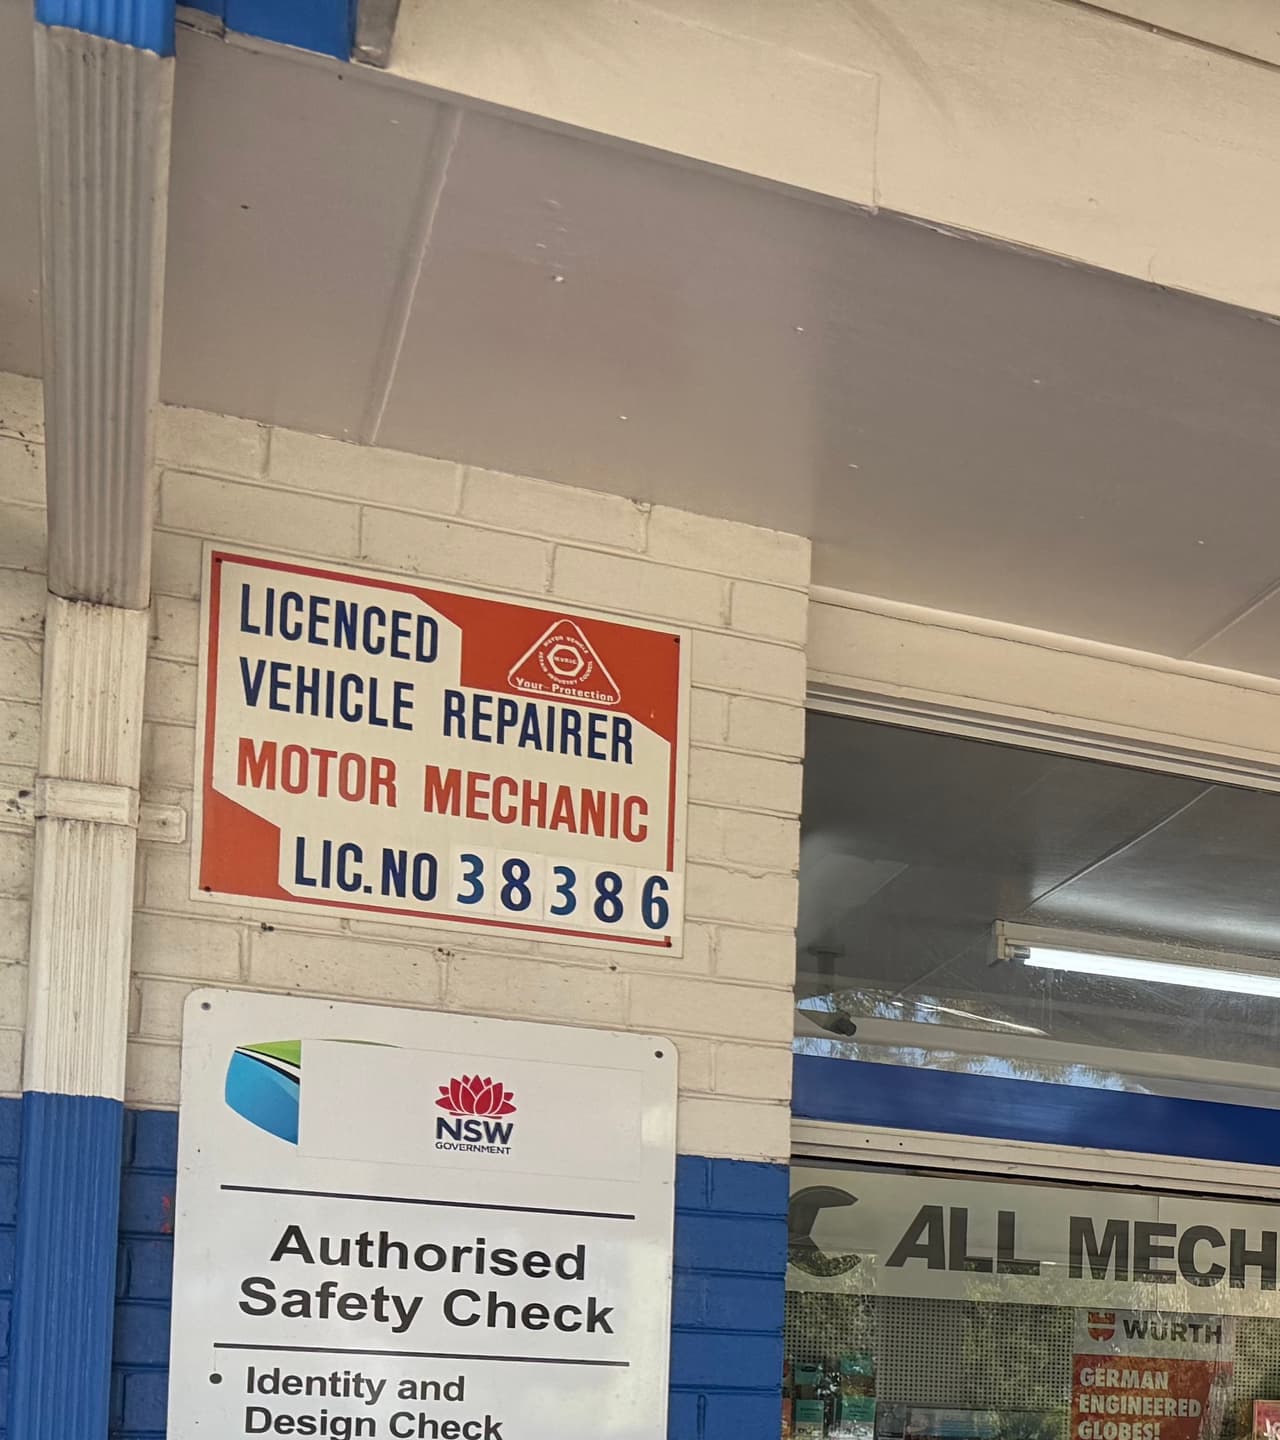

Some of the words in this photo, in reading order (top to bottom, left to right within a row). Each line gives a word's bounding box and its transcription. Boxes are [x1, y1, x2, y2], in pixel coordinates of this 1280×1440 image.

[240, 583, 439, 664] LICENCED
[239, 656, 414, 731] VEHICLE
[443, 689, 633, 764] REPAIRER
[552, 683, 614, 702] Protection
[236, 737, 397, 808] MOTOR
[423, 764, 649, 842] MECHANIC
[294, 836, 438, 901] LIC.NO
[455, 853, 670, 930] 38386
[435, 1117, 514, 1146] NSW
[435, 1141, 511, 1155] GOVERNMENT
[269, 1223, 587, 1281] Authorised
[885, 1204, 1042, 1277] ALL
[237, 1276, 424, 1335] Safety
[442, 1287, 615, 1335] Check
[245, 1366, 387, 1406] Identity
[397, 1375, 466, 1403] and
[1078, 1393, 1201, 1418] ENGINEERED
[1080, 1367, 1169, 1390] GERMAN
